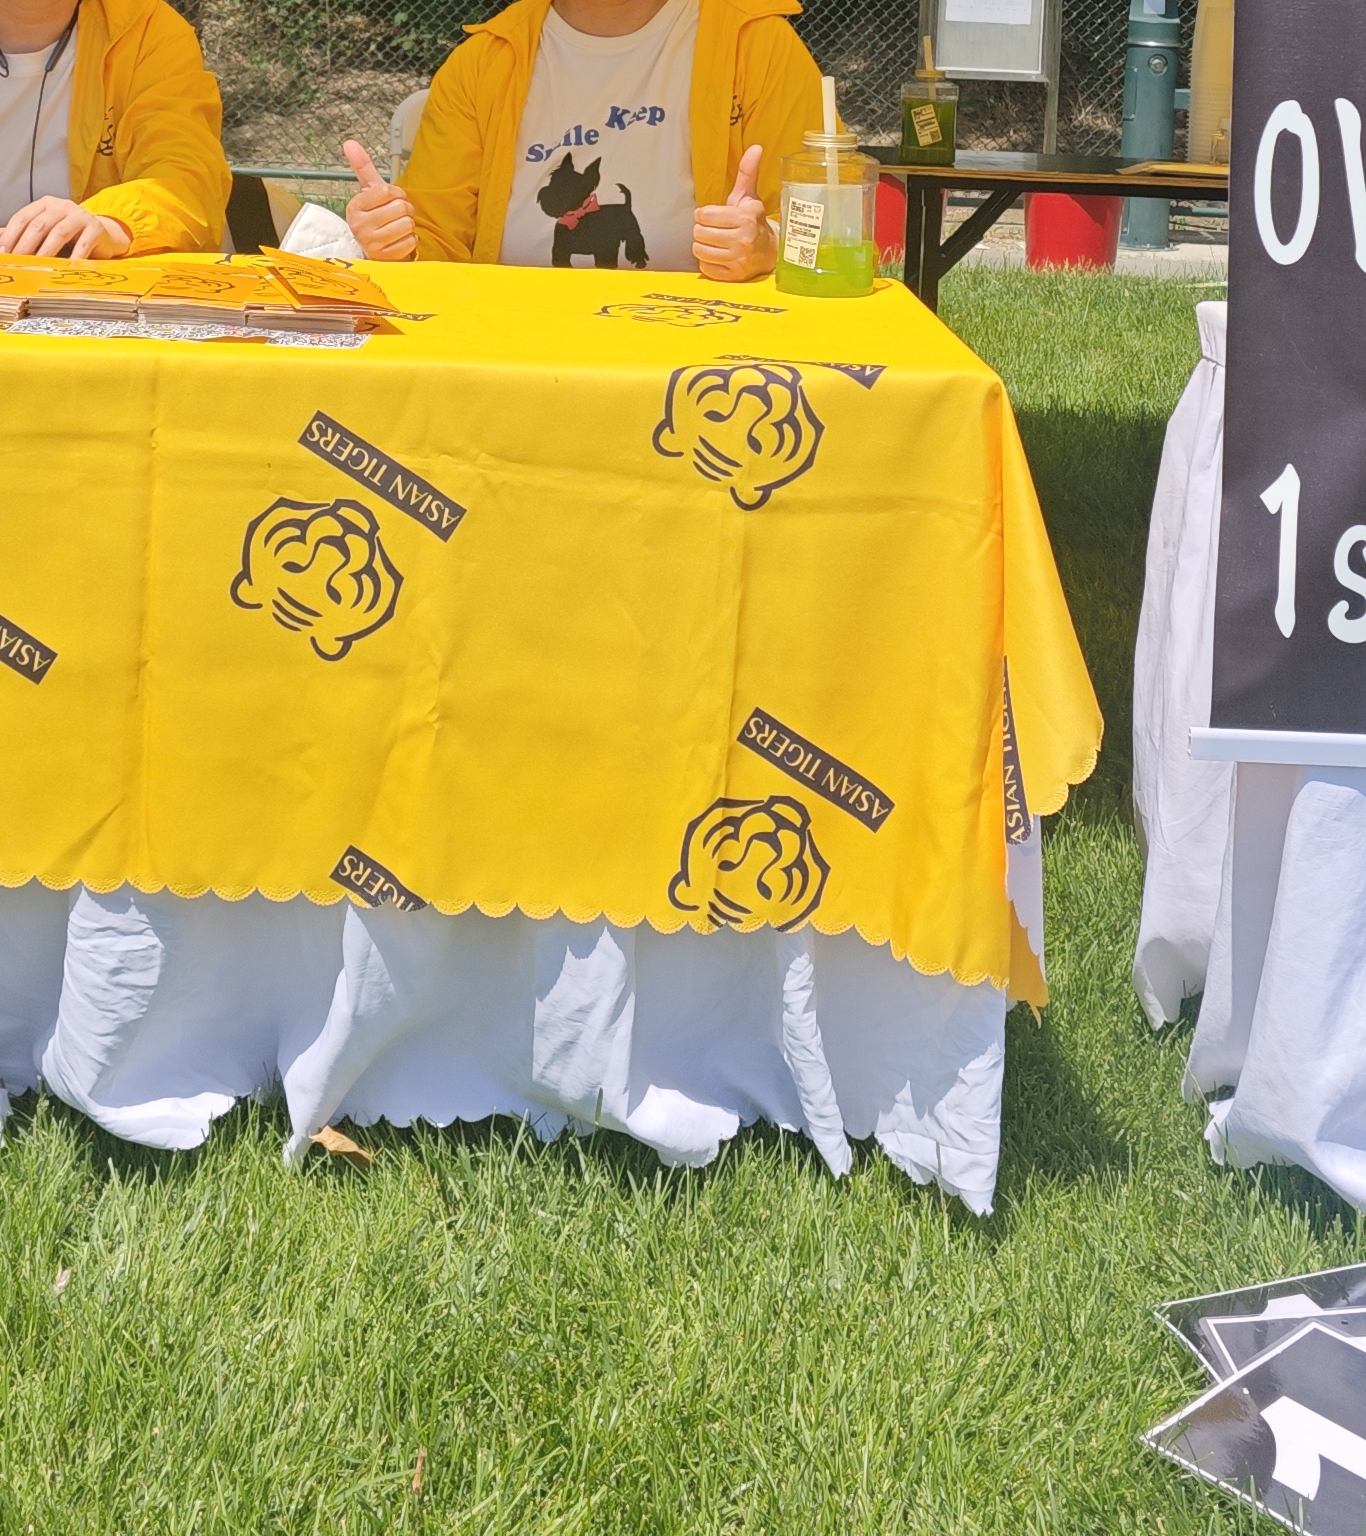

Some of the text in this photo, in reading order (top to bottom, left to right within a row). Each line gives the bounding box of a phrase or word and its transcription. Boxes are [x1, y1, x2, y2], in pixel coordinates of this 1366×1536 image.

[305, 418, 460, 530] ASIAN TIGERS
[743, 714, 890, 822] ASIAN TIGERS
